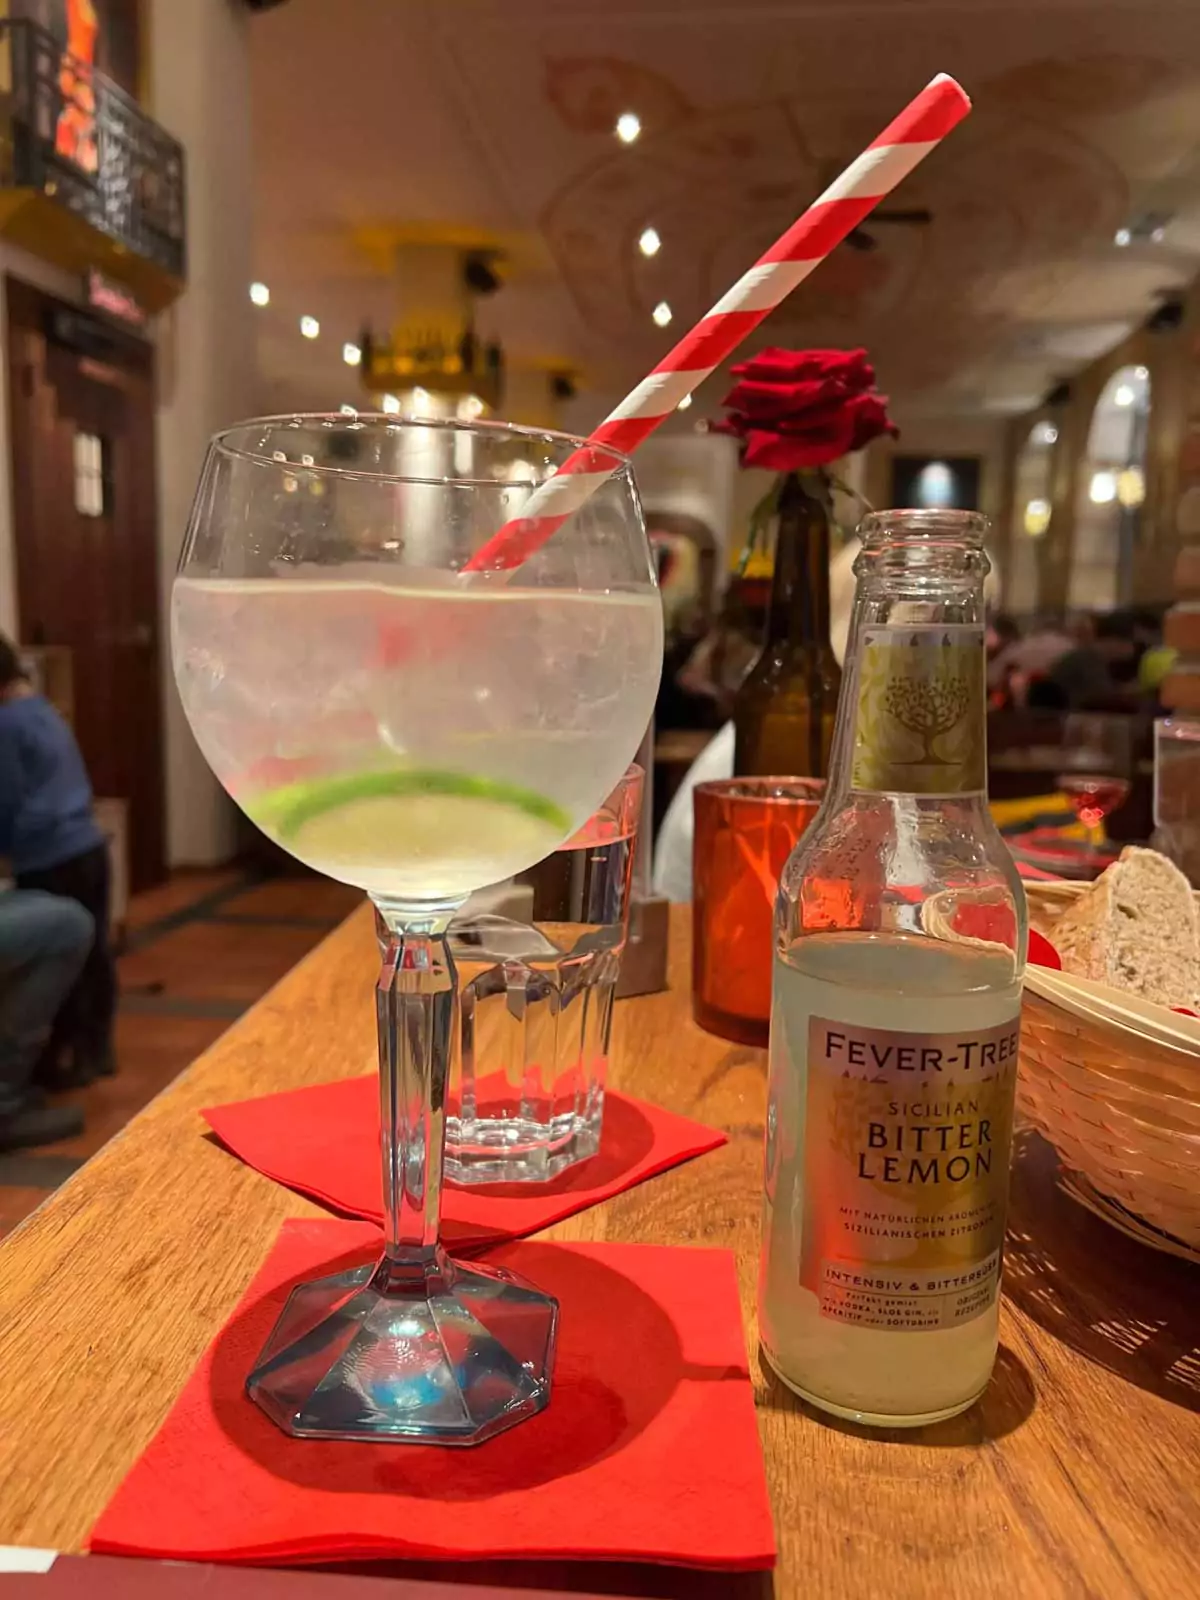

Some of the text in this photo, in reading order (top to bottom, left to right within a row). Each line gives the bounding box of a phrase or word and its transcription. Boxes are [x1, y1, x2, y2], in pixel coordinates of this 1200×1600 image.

[825, 1031, 1018, 1072] FEVER-TREE
[888, 1099, 979, 1117] SICILIAN
[868, 1119, 992, 1152] BITTER
[858, 1148, 992, 1184] LEMON
[839, 1206, 860, 1217] MIT
[844, 1221, 945, 1239] SIZILIANISCHEN
[825, 1268, 903, 1291] INTENSIV
[909, 1283, 920, 1291] &
